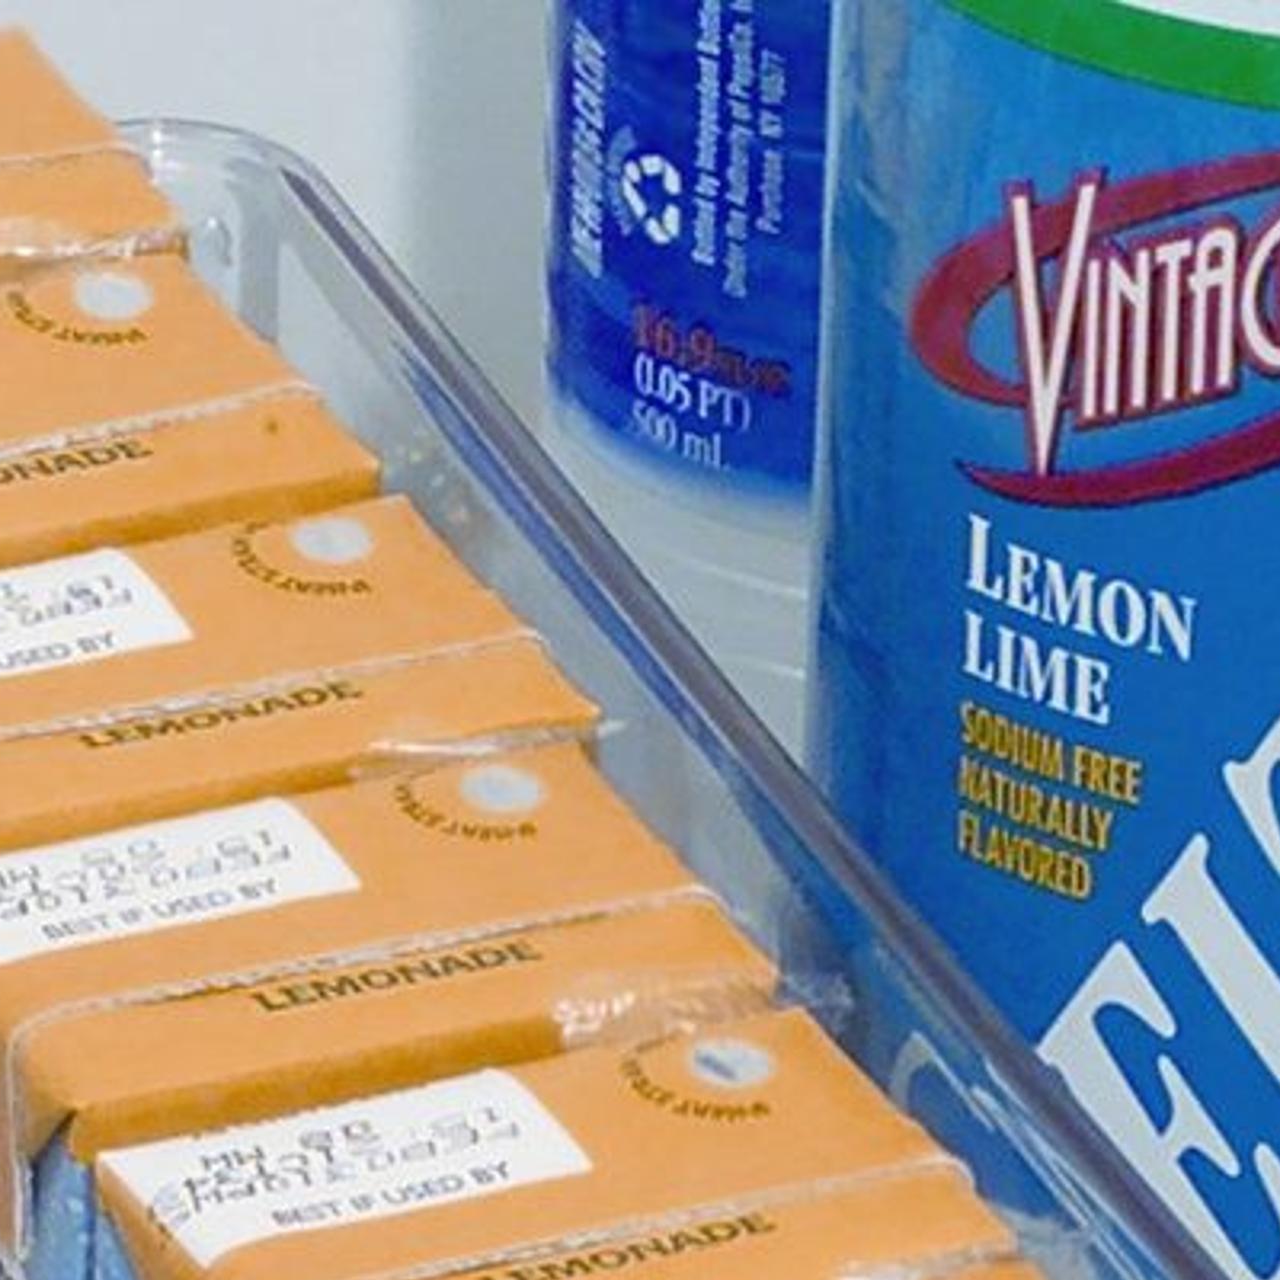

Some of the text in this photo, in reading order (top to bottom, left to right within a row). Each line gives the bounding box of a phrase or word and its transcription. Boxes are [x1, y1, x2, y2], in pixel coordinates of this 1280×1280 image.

[965, 512, 1198, 664] LEMON
[964, 611, 1112, 727] LIME
[79, 678, 365, 752] LEMONADE
[959, 702, 1142, 808] SODIUM FREE
[957, 755, 1114, 849] NATURALLY
[956, 817, 1095, 903] FLAVORED
[41, 912, 112, 940] BEST
[151, 887, 232, 918] USED
[253, 937, 541, 1014] LEMONADE
[273, 1198, 340, 1230] BEST
[381, 1170, 464, 1206] USED
